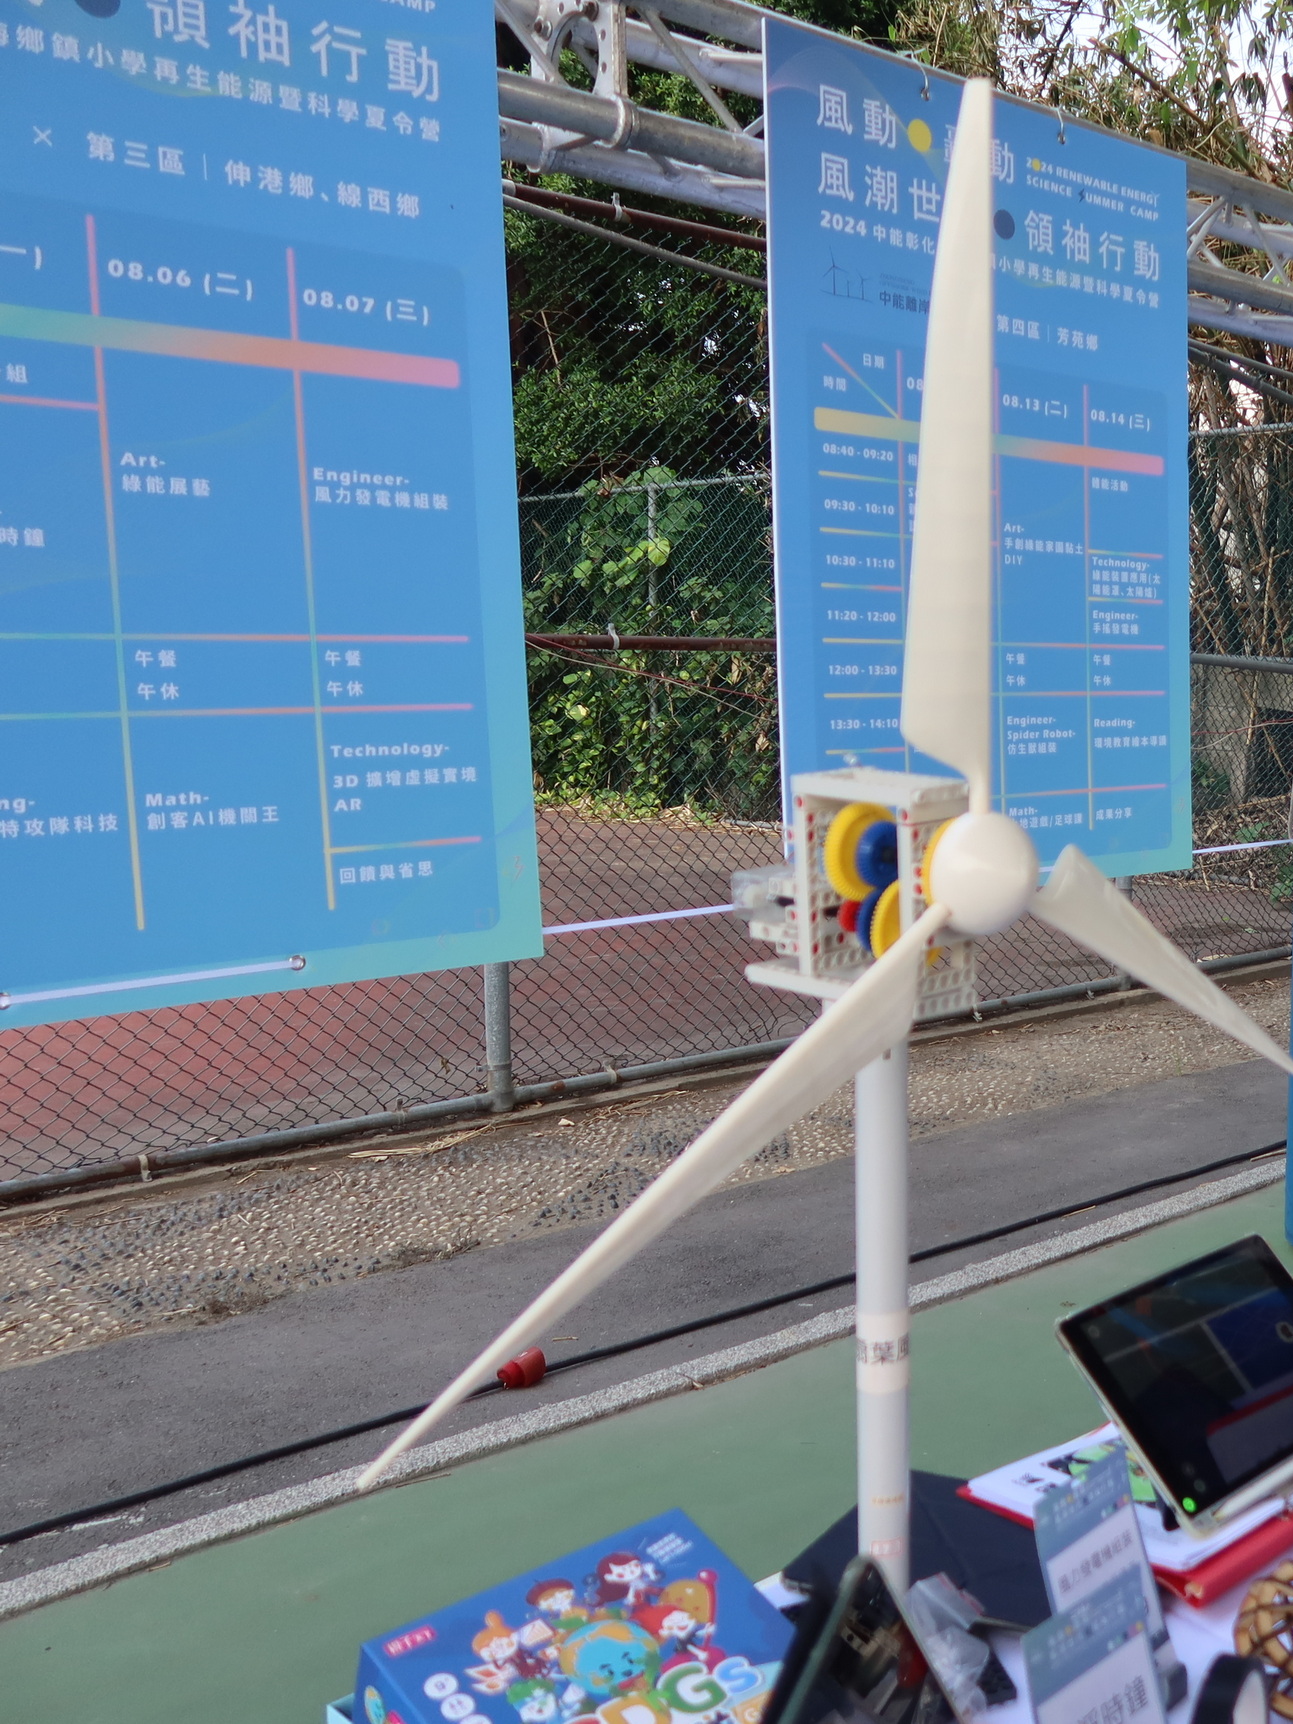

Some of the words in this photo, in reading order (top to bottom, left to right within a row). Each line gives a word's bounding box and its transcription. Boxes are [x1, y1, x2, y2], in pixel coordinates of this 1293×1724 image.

[146, 0, 440, 102] 領袖行動
[817, 84, 897, 149] 風動
[86, 131, 186, 176] 第三區
[1056, 166, 1119, 194] RENEWABLE
[1026, 175, 1072, 197] SCIENCE
[1130, 205, 1159, 222] CAMP
[820, 210, 867, 237] 2024
[1024, 209, 1159, 282] 領袖行動
[107, 259, 192, 288] 08.06
[204, 271, 254, 301] (二)
[303, 289, 375, 314] 08.07
[386, 300, 431, 326] (三)
[996, 314, 1040, 340] 第四區
[1057, 327, 1098, 351] 芳苑鄉
[862, 353, 885, 369] 日期
[823, 375, 847, 392] 時間
[1002, 394, 1040, 411] 08.13
[1044, 400, 1067, 419] (二)
[1090, 409, 1125, 425] 08.14
[1129, 413, 1150, 432] (三)
[313, 468, 410, 487] Engineer-
[314, 486, 449, 511] 風力發電機組裝
[1004, 555, 1023, 565] DIY
[1092, 556, 1150, 571] Technology-
[1093, 610, 1138, 621] Engineer-
[135, 649, 177, 668] 午餐
[325, 650, 361, 667] 午餐
[1006, 653, 1025, 665] 午餐
[1093, 654, 1111, 666] 午餐
[1006, 674, 1026, 686] 午休
[1093, 674, 1112, 686] 午休
[137, 682, 180, 700] 午休
[327, 681, 363, 697] 午休
[1007, 715, 1056, 728] Engineer-
[1094, 718, 1136, 728] Reading-
[1007, 730, 1039, 742] Spider
[330, 742, 450, 758] Technology-
[333, 775, 359, 788] 3D
[145, 791, 210, 807] Math-
[334, 798, 362, 812] AR
[1012, 812, 1083, 829] 地遊戲/足球課
[1095, 807, 1133, 821] 成果分享
[339, 861, 433, 884] 回饋與省思
